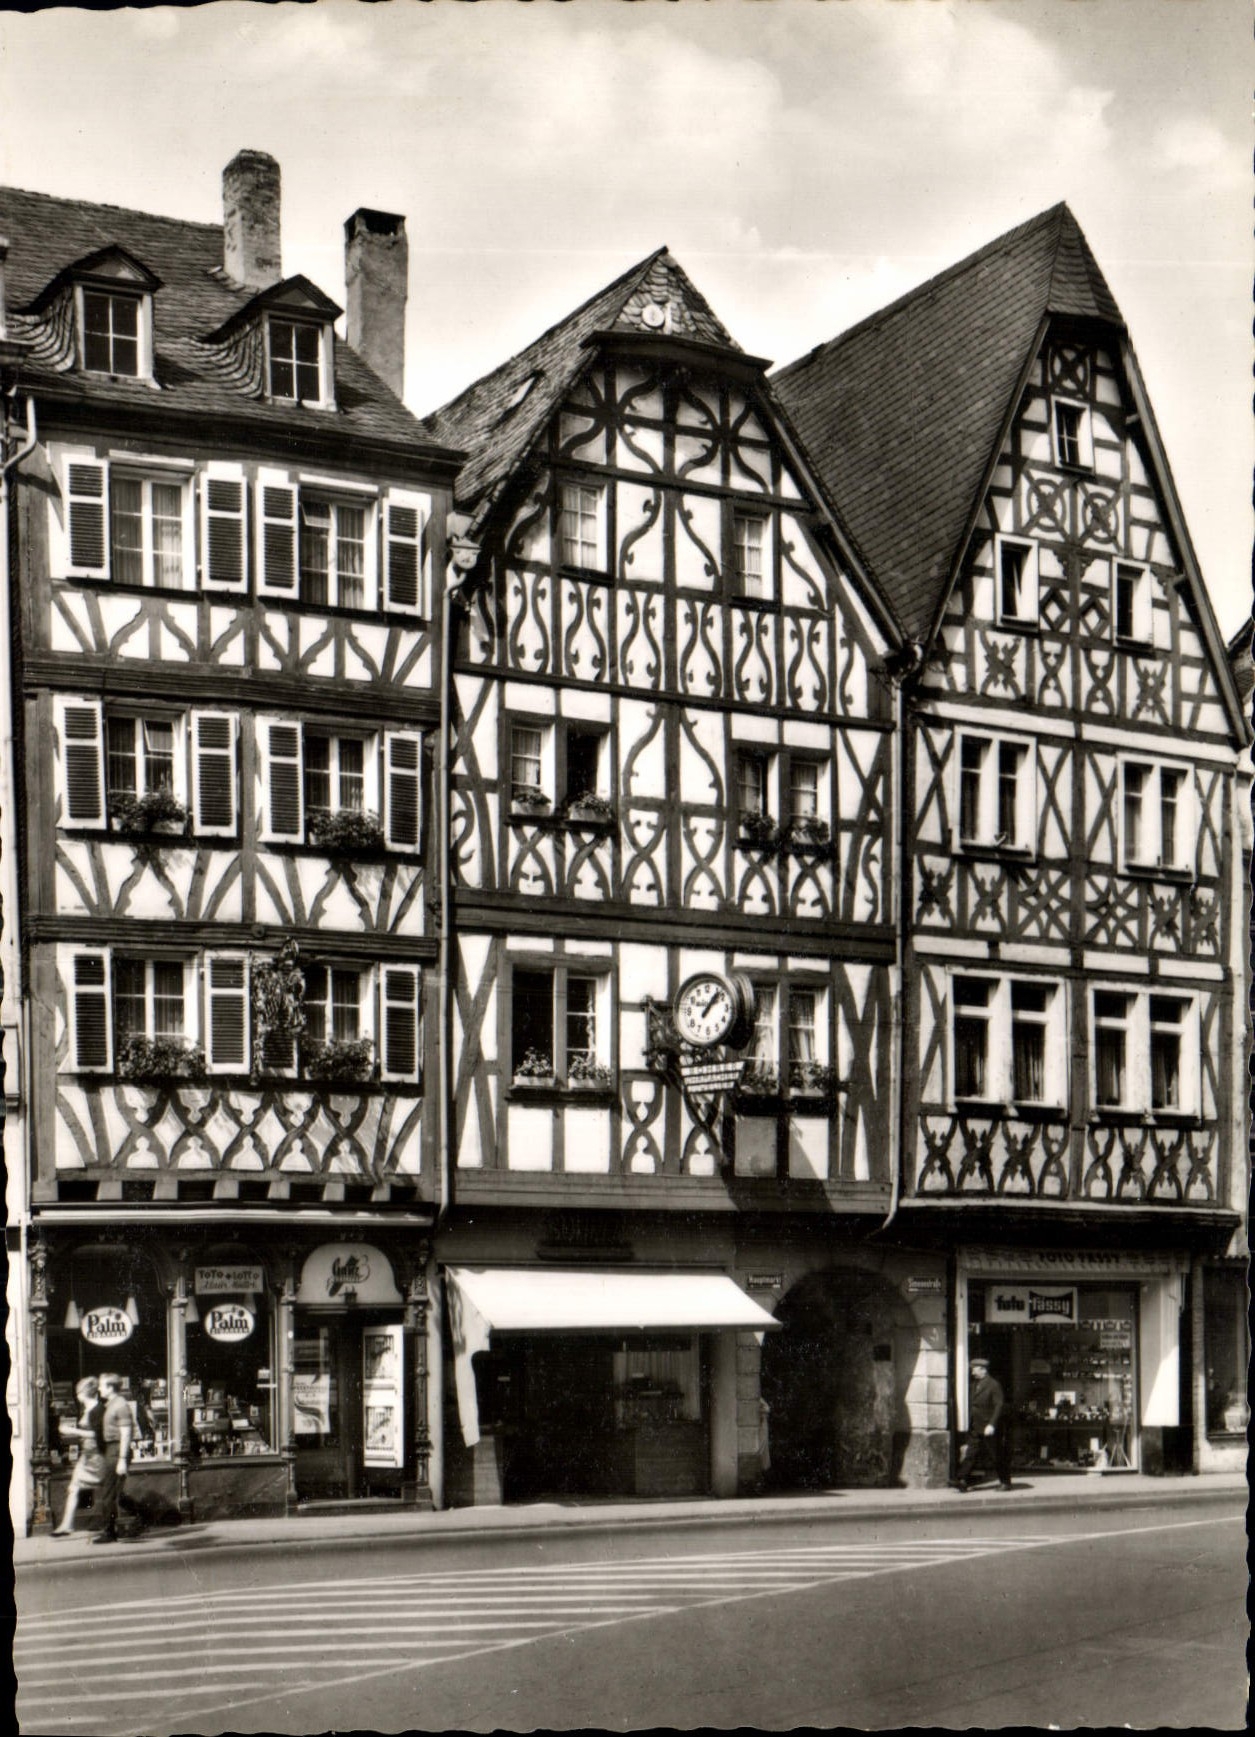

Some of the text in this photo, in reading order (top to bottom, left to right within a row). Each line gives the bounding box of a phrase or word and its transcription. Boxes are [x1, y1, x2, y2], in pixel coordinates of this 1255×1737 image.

[994, 1295, 1070, 1316] foto fässy
[87, 1314, 125, 1333] Palm
[210, 1311, 249, 1330] Palm
